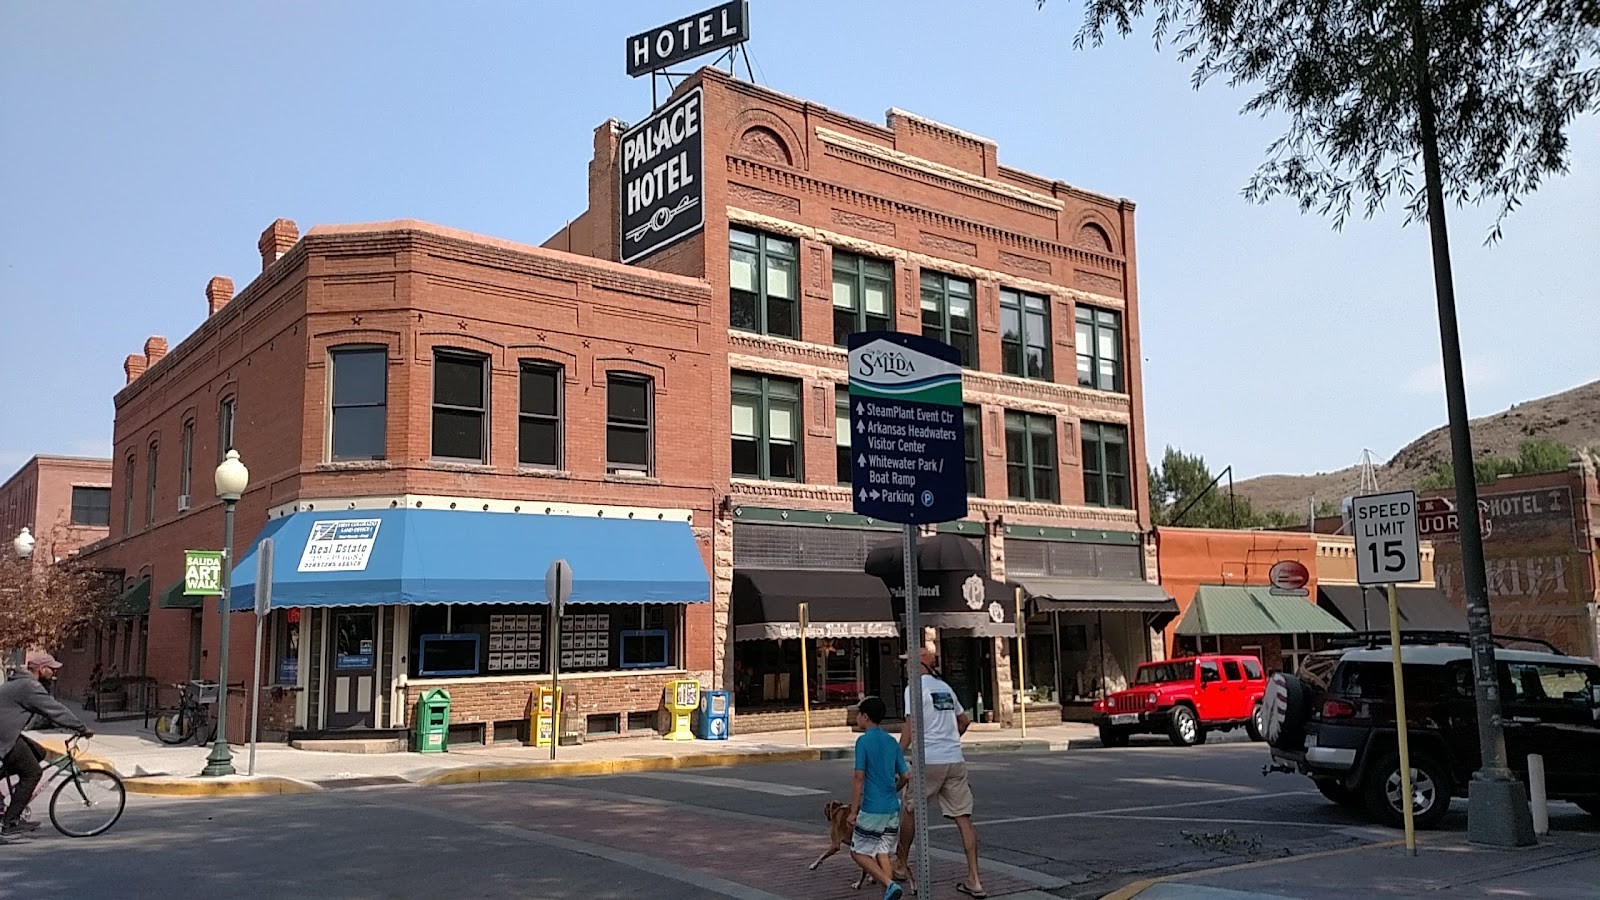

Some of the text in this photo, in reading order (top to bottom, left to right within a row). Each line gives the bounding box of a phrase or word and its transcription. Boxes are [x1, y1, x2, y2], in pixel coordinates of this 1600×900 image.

[634, 8, 737, 67] HOTEL
[624, 97, 699, 175] PALACE
[627, 151, 694, 216] HOTEL
[867, 403, 954, 423] SteamPlant Event Ctr
[868, 421, 956, 441] Arkansas Headwaters
[868, 436, 926, 453] Visitor Center
[869, 455, 916, 470] Whitewater
[918, 459, 937, 472] Park
[869, 471, 916, 487] Boat Ramp
[882, 489, 914, 506] Parking
[1490, 495, 1542, 516] HOTEL
[1359, 502, 1410, 519] SPEED
[1365, 521, 1405, 537] LIMIT
[309, 544, 367, 554] Real Estate
[1368, 540, 1406, 573] 15
[187, 557, 221, 566] SALIDA
[185, 565, 221, 580] ART
[187, 579, 218, 589] WALK
